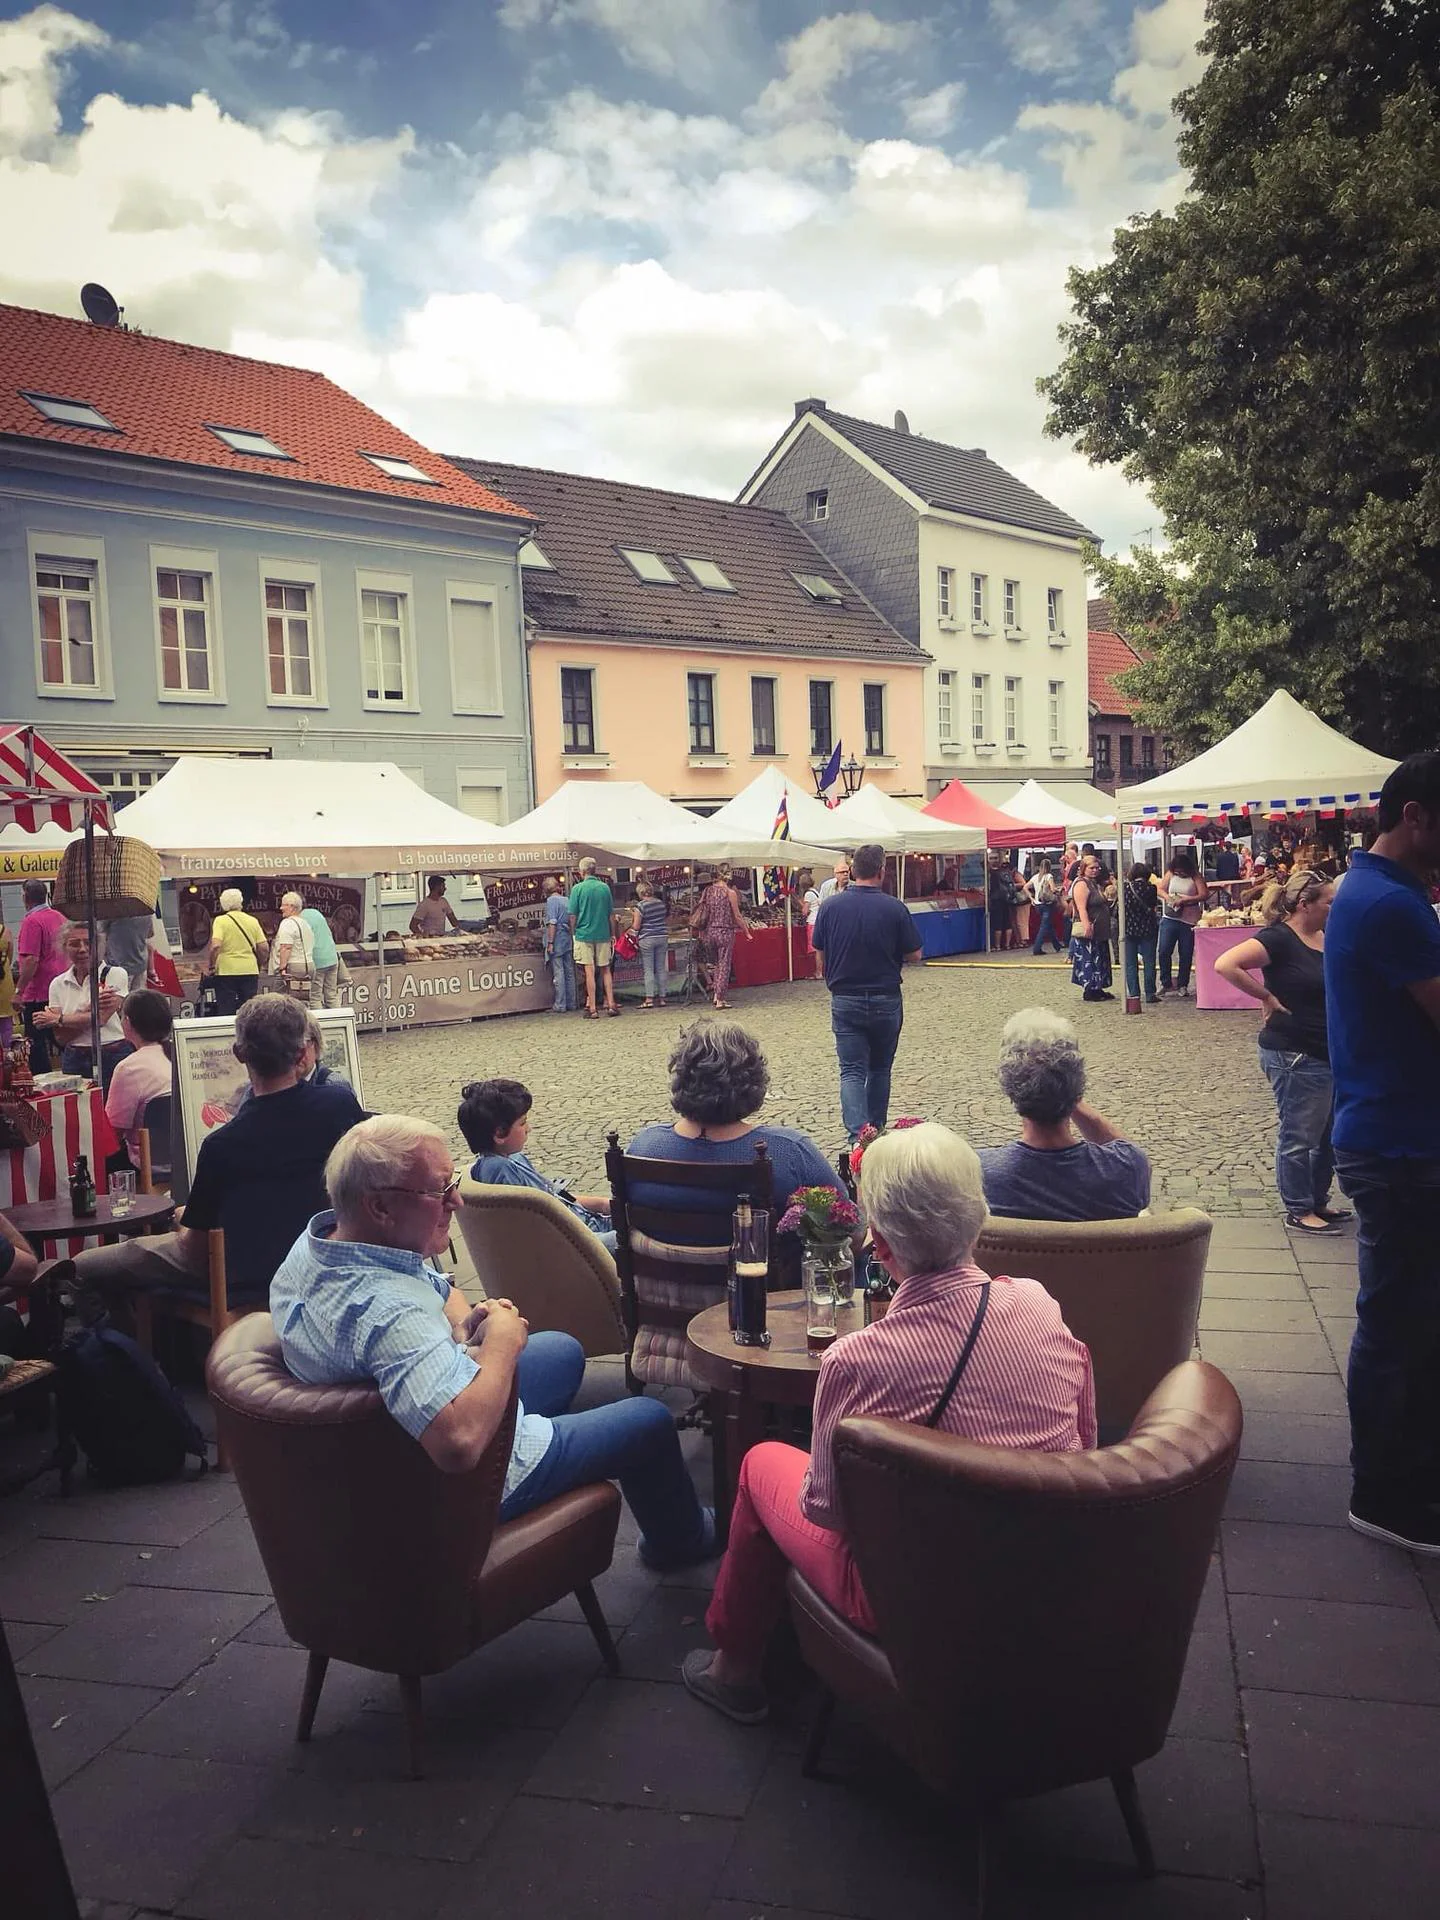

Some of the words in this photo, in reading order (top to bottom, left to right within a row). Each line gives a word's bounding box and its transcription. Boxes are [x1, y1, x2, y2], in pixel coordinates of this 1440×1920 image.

[4, 855, 15, 873] &
[20, 854, 61, 873] Galett
[180, 853, 291, 870] franzosisches
[294, 852, 328, 868] brot
[398, 851, 414, 865] La
[417, 850, 495, 867] boulangerie
[510, 848, 540, 862] Anne
[543, 848, 578, 861] Louise
[246, 898, 268, 911] Aus
[497, 892, 536, 909] Bergkäse
[400, 974, 461, 999] Anne
[467, 965, 534, 993] Louise
